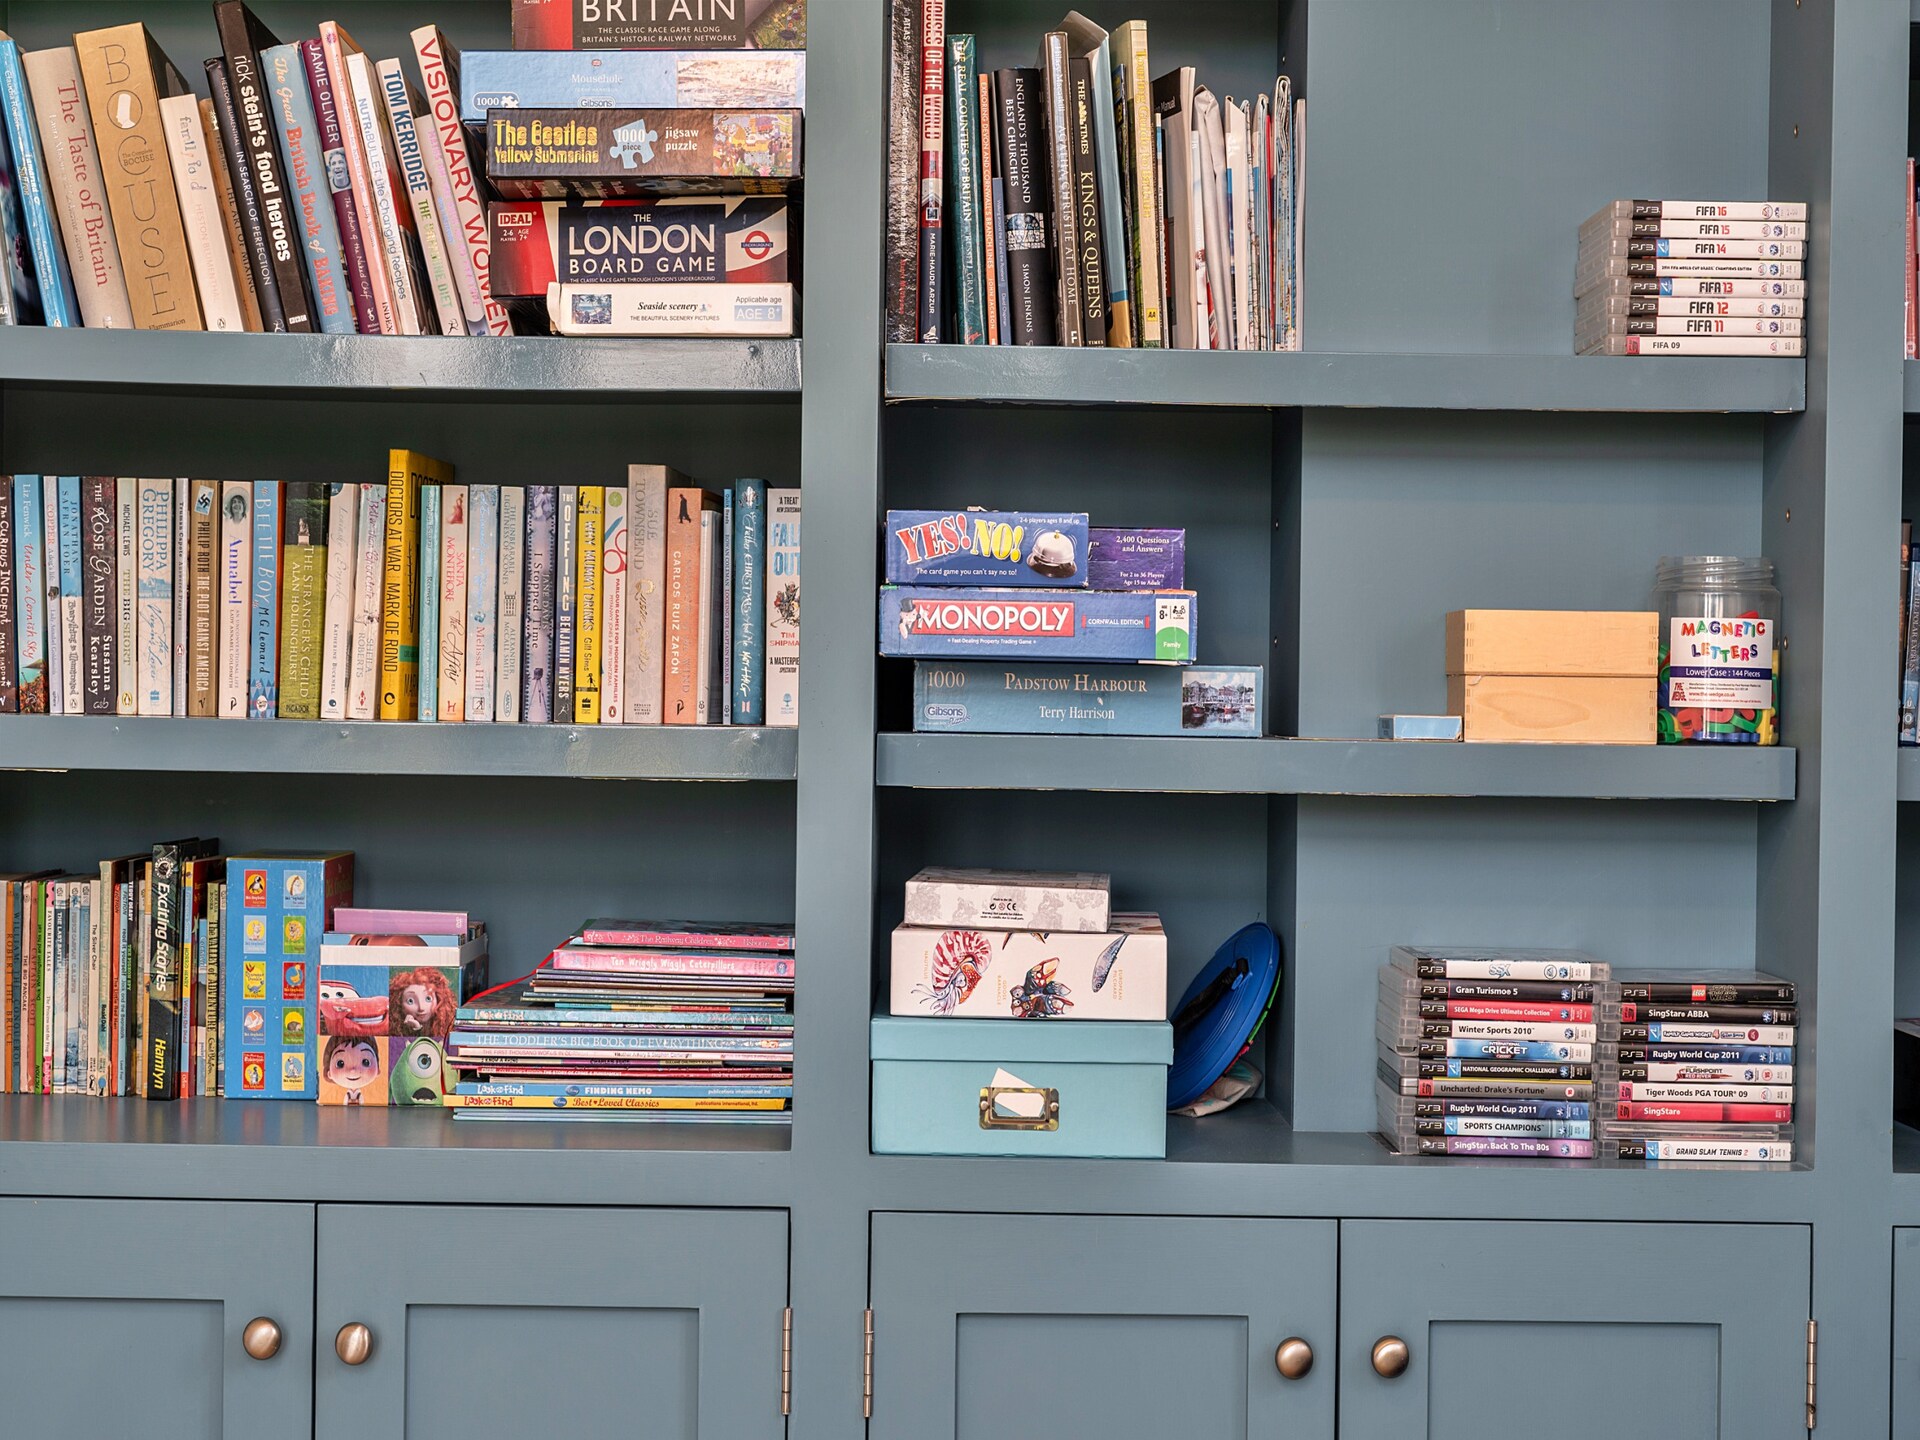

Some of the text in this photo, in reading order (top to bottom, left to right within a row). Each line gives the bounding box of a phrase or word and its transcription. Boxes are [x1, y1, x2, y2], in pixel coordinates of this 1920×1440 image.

[620, 35, 656, 43] HISTORIC
[658, 35, 693, 43] RAILWAY
[925, 50, 942, 90] OF THE
[58, 80, 80, 124] The
[309, 44, 340, 144] JAMIE OLIVER
[476, 96, 500, 106] 1000
[384, 70, 428, 194] TOM KERRIDGE
[420, 38, 478, 206] VISIONARY
[665, 126, 700, 140] jigsaw
[617, 128, 646, 143] 1000
[622, 143, 642, 152] piece
[665, 140, 698, 152] puzzle
[1006, 98, 1019, 186] BEST CHURCHES
[1016, 78, 1032, 204] ENGLAND'S THOUSAND
[1080, 124, 1089, 154] TIMES
[68, 129, 88, 182] Taste
[234, 55, 291, 262] rick stein's food heroes
[78, 188, 102, 211] of
[418, 200, 432, 220] THE
[1696, 206, 1727, 216] FIFA 16
[239, 166, 272, 286] SEARCH OF PERFECTION
[300, 192, 323, 238] Book
[499, 214, 532, 226] IDEAL
[634, 214, 652, 222] THE
[568, 224, 716, 255] LONDON
[1700, 224, 1719, 234] FIFA
[84, 216, 112, 287] Britain
[1080, 171, 1102, 318] KINGS & QUEENS
[1695, 244, 1726, 254] FIFA 14
[392, 254, 406, 300] Recipes
[569, 256, 716, 274] BOARD GAME
[1065, 248, 1078, 305] AT HOME
[1022, 264, 1034, 333] SIMON JENKINS
[1699, 282, 1733, 293] FIFA 13
[382, 301, 394, 332] INDEX
[638, 301, 699, 313] Seaside scenery
[736, 308, 764, 320] AGE
[1689, 302, 1728, 314] FIFA 12
[1686, 320, 1724, 332] FIFA 11
[142, 488, 156, 572] GREGORY
[156, 490, 170, 571] PHILIPPA
[896, 514, 1024, 565] YES! NO!
[122, 504, 131, 621] MICHAEL BIG
[228, 534, 243, 604] Annabel
[384, 470, 404, 673] DOCTORS AT WAR MARK DE ROND
[584, 550, 596, 590] MUMMY
[196, 521, 210, 692] PHILIP ROTH THE AGAINST AMERICA
[558, 504, 572, 698] OFFING BENJAMIN MYERS
[670, 551, 682, 675] CARLOS RUIZ ZAFÓN
[300, 545, 314, 698] THE STRANGER'S CHILD
[918, 602, 1069, 632] MONOPOLY
[1088, 618, 1144, 626] CORNWALL EDITION
[1681, 620, 1766, 638] MAGNETIC
[1163, 641, 1182, 650] Family
[1692, 642, 1758, 663] LETTERS
[89, 636, 100, 696] Kearsley
[103, 635, 112, 692] Susanna
[928, 671, 965, 689] 1000
[927, 706, 964, 718] Gibsons
[1039, 706, 1115, 721] Terry Harrison
[155, 882, 170, 992] Exciting Stories
[610, 957, 625, 966] Ten
[1456, 986, 1474, 994] Gran
[208, 978, 217, 1032] ADVENTURE
[476, 1034, 646, 1048] THE TODDLER'S BIG BOOK OF
[1458, 1025, 1512, 1035] Winter Sports
[1482, 1046, 1528, 1054] CRICKET
[1652, 1050, 1678, 1060] Rugby
[1679, 1051, 1703, 1059] World
[1704, 1052, 1720, 1060] Cup
[152, 1038, 166, 1090] Hamlyn
[585, 1086, 652, 1096] FINDING NEMO
[1646, 1089, 1666, 1097] Tiger
[1450, 1104, 1474, 1114] Rugby
[1502, 1106, 1518, 1114] Cup
[1464, 1122, 1493, 1130] SPORTS
